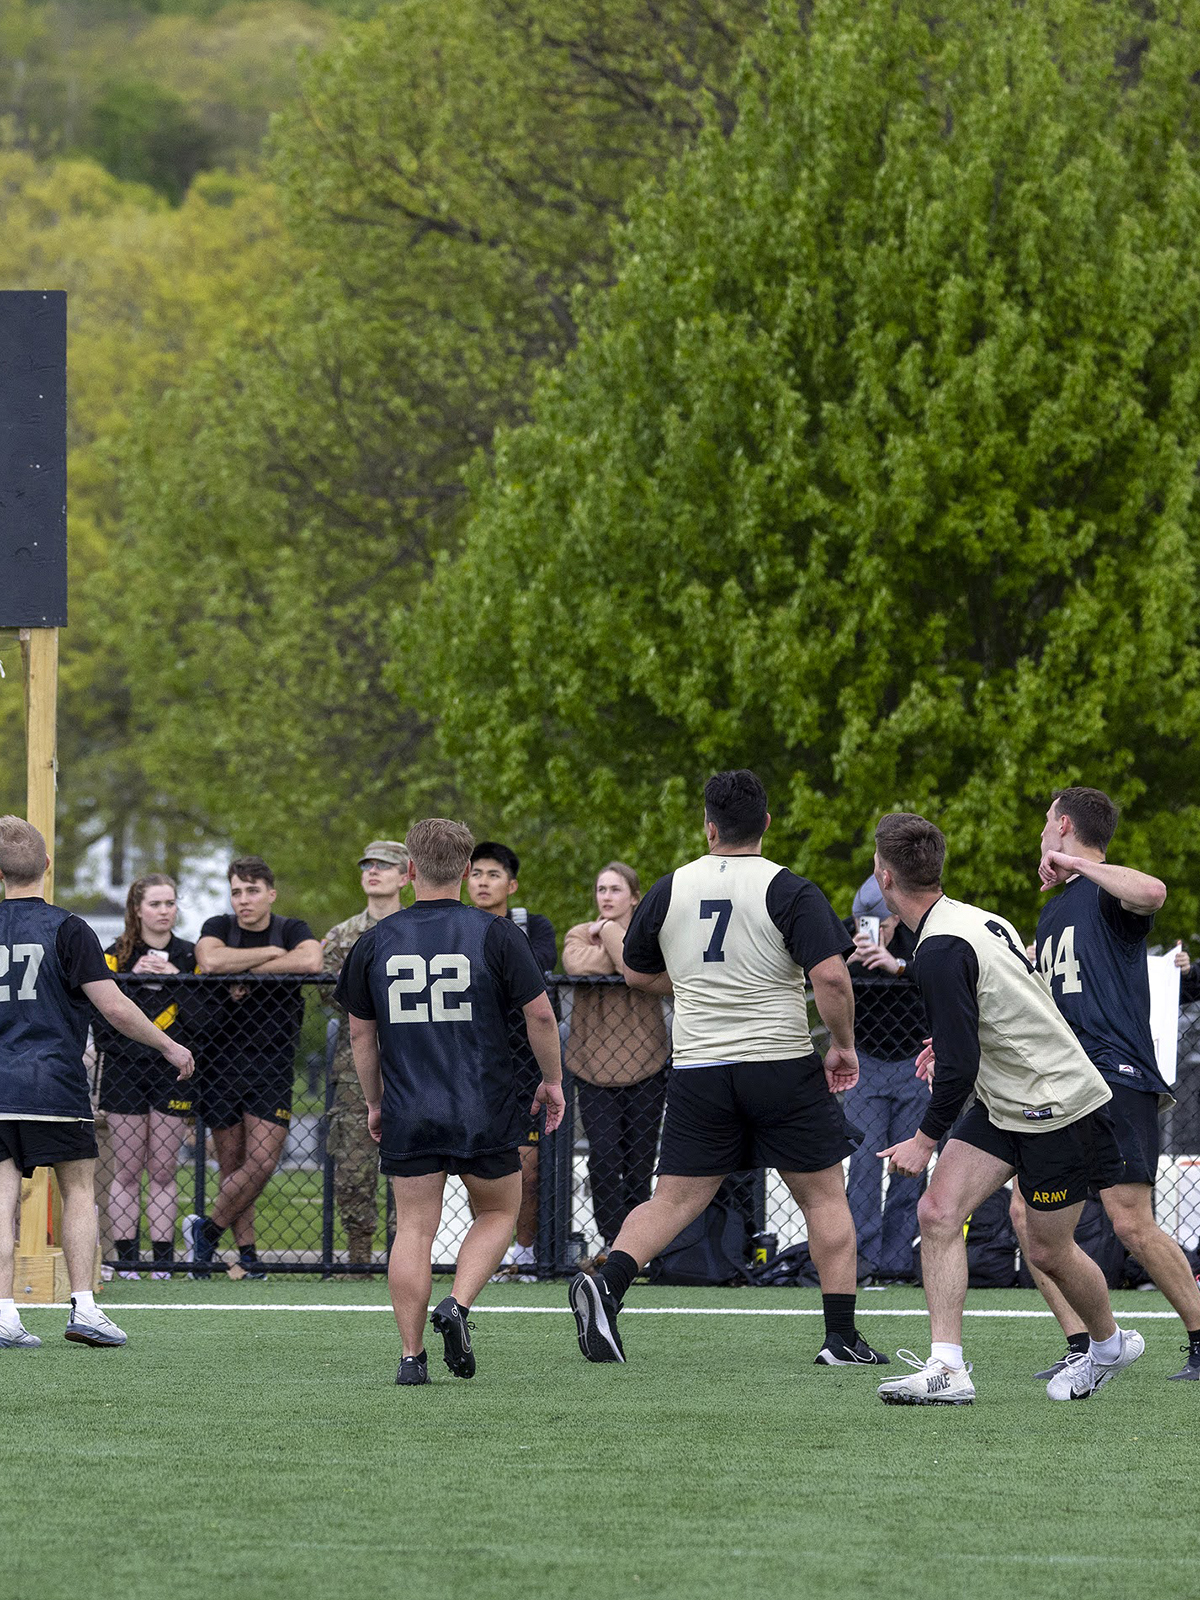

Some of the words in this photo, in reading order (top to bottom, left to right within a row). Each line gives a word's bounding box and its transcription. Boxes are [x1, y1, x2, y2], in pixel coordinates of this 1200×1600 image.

[699, 898, 733, 962] 7
[1040, 925, 1083, 994] 44
[386, 953, 472, 1024] 22
[1032, 1188, 1068, 1204] ARMY
[926, 1372, 951, 1393] NIKE
